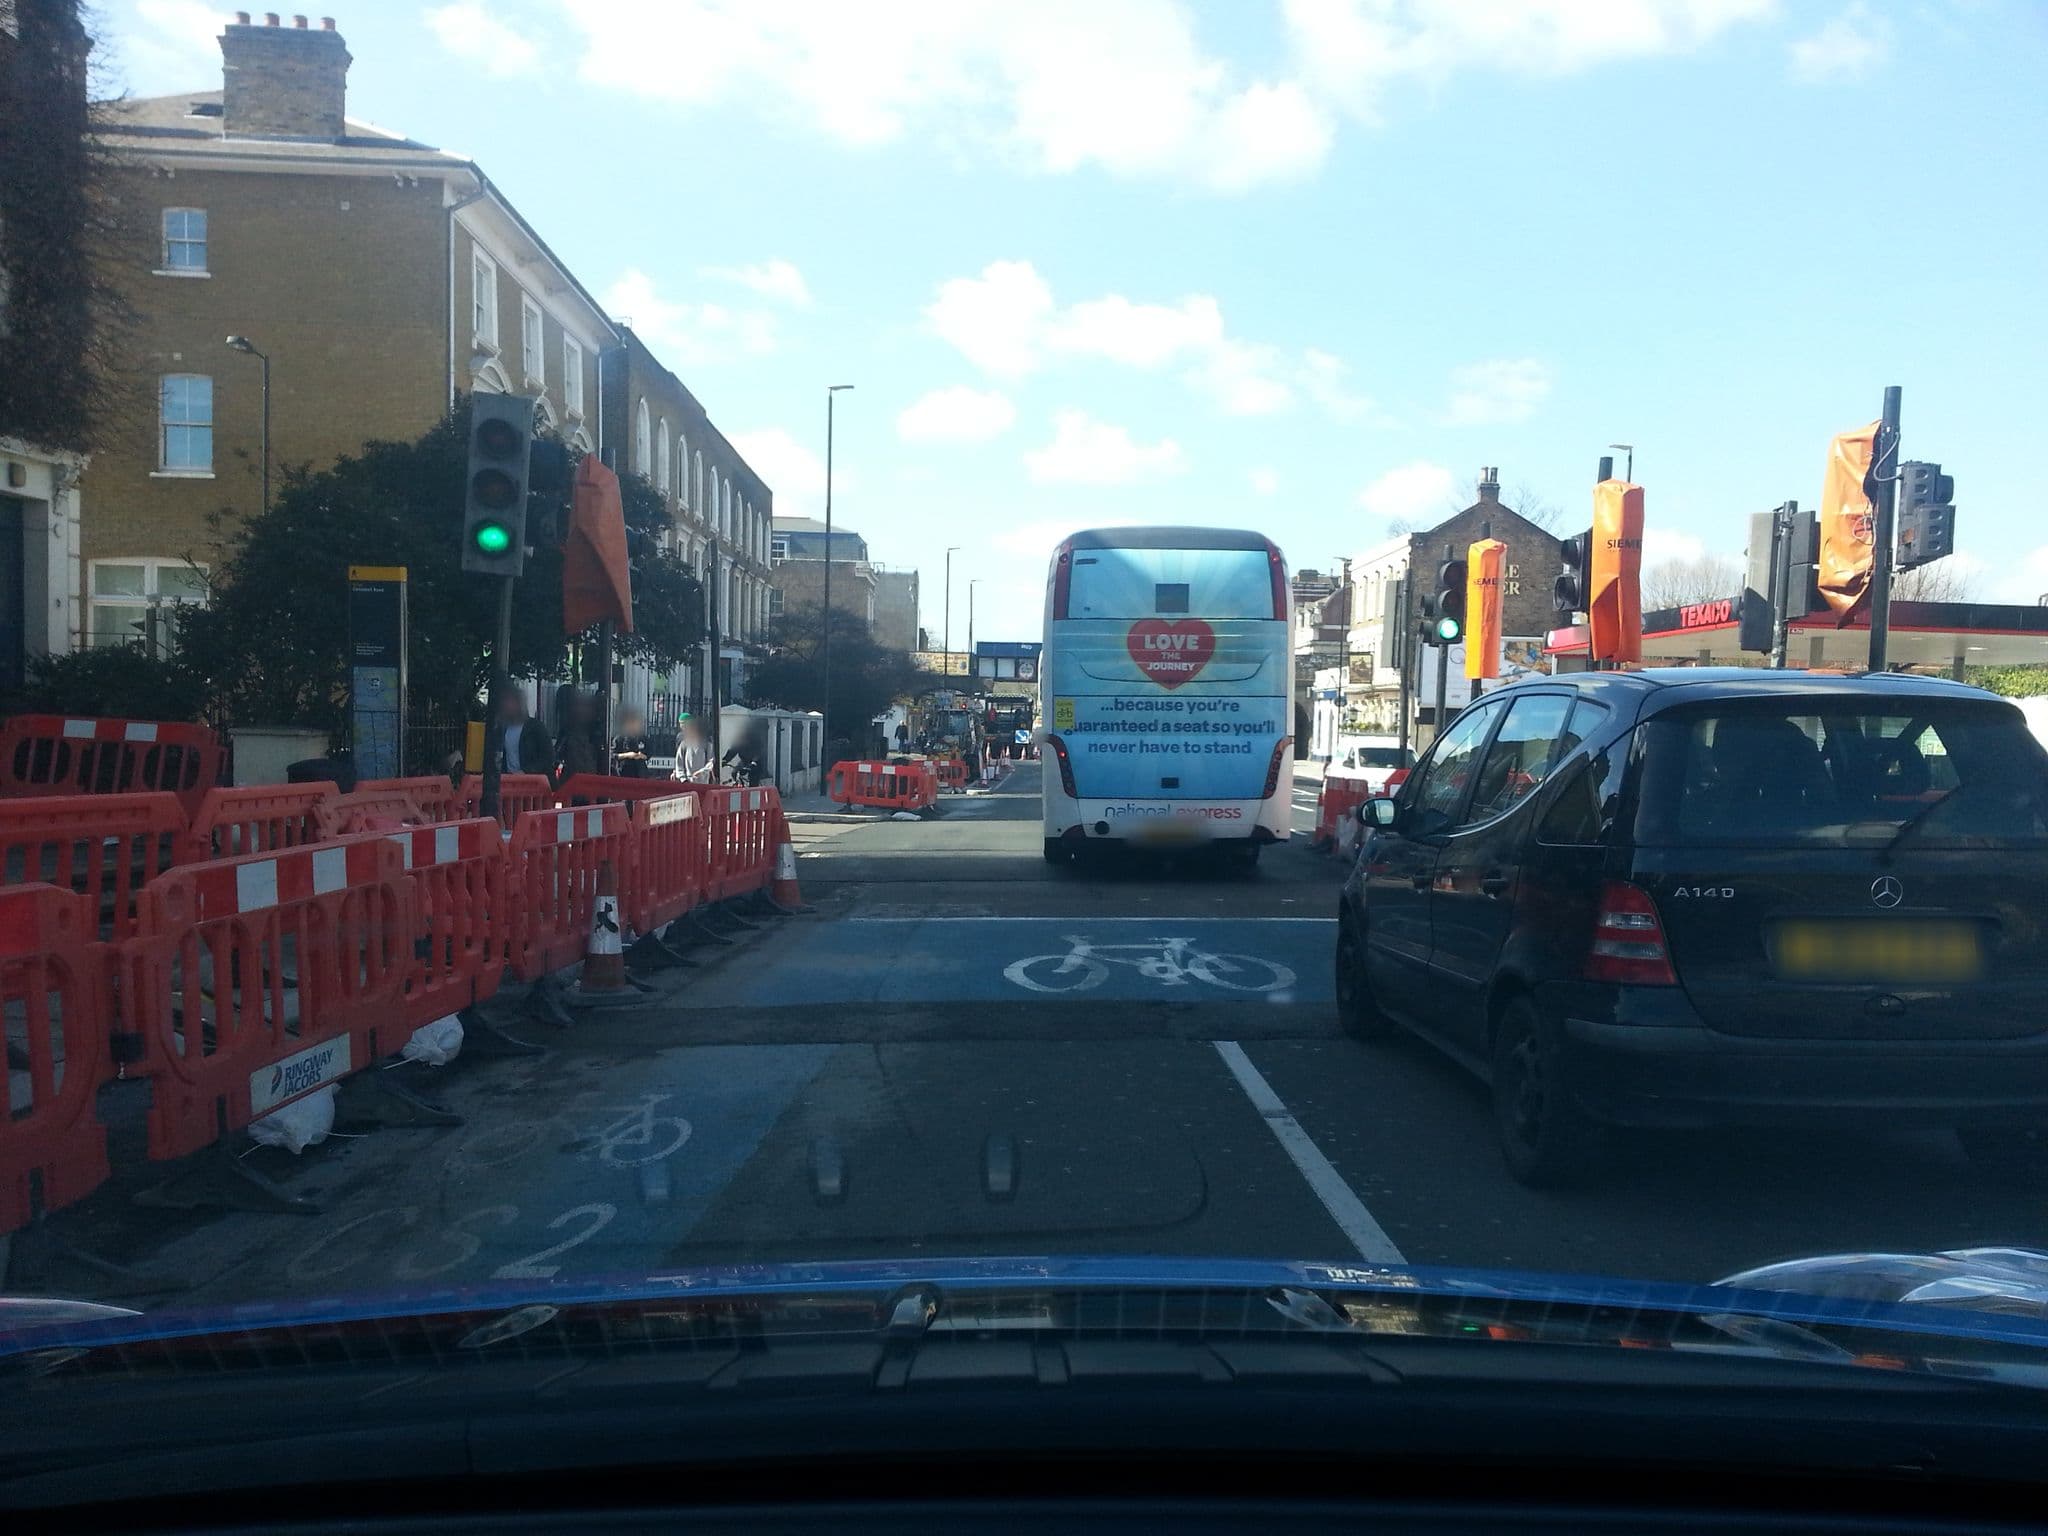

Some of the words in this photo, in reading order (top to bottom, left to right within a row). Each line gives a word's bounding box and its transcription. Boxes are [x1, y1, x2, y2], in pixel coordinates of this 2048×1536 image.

[1681, 599, 1731, 627] TEXACO
[1144, 634, 1199, 650] LOVE
[1161, 652, 1181, 660] THE
[1147, 662, 1195, 671] JOURNEY
[1187, 699, 1240, 714] you're
[1162, 723, 1172, 733] a
[1174, 721, 1209, 733] seat
[1212, 723, 1231, 733] so
[1233, 720, 1275, 736] you'll
[1088, 742, 1136, 754] never
[1139, 740, 1179, 754] have
[1184, 742, 1202, 754] to
[1204, 741, 1251, 754] stand
[1105, 803, 1171, 818] national
[1674, 886, 1735, 898] A140
[285, 1048, 333, 1080] RINGWAY
[284, 1068, 321, 1098] JACOBS
